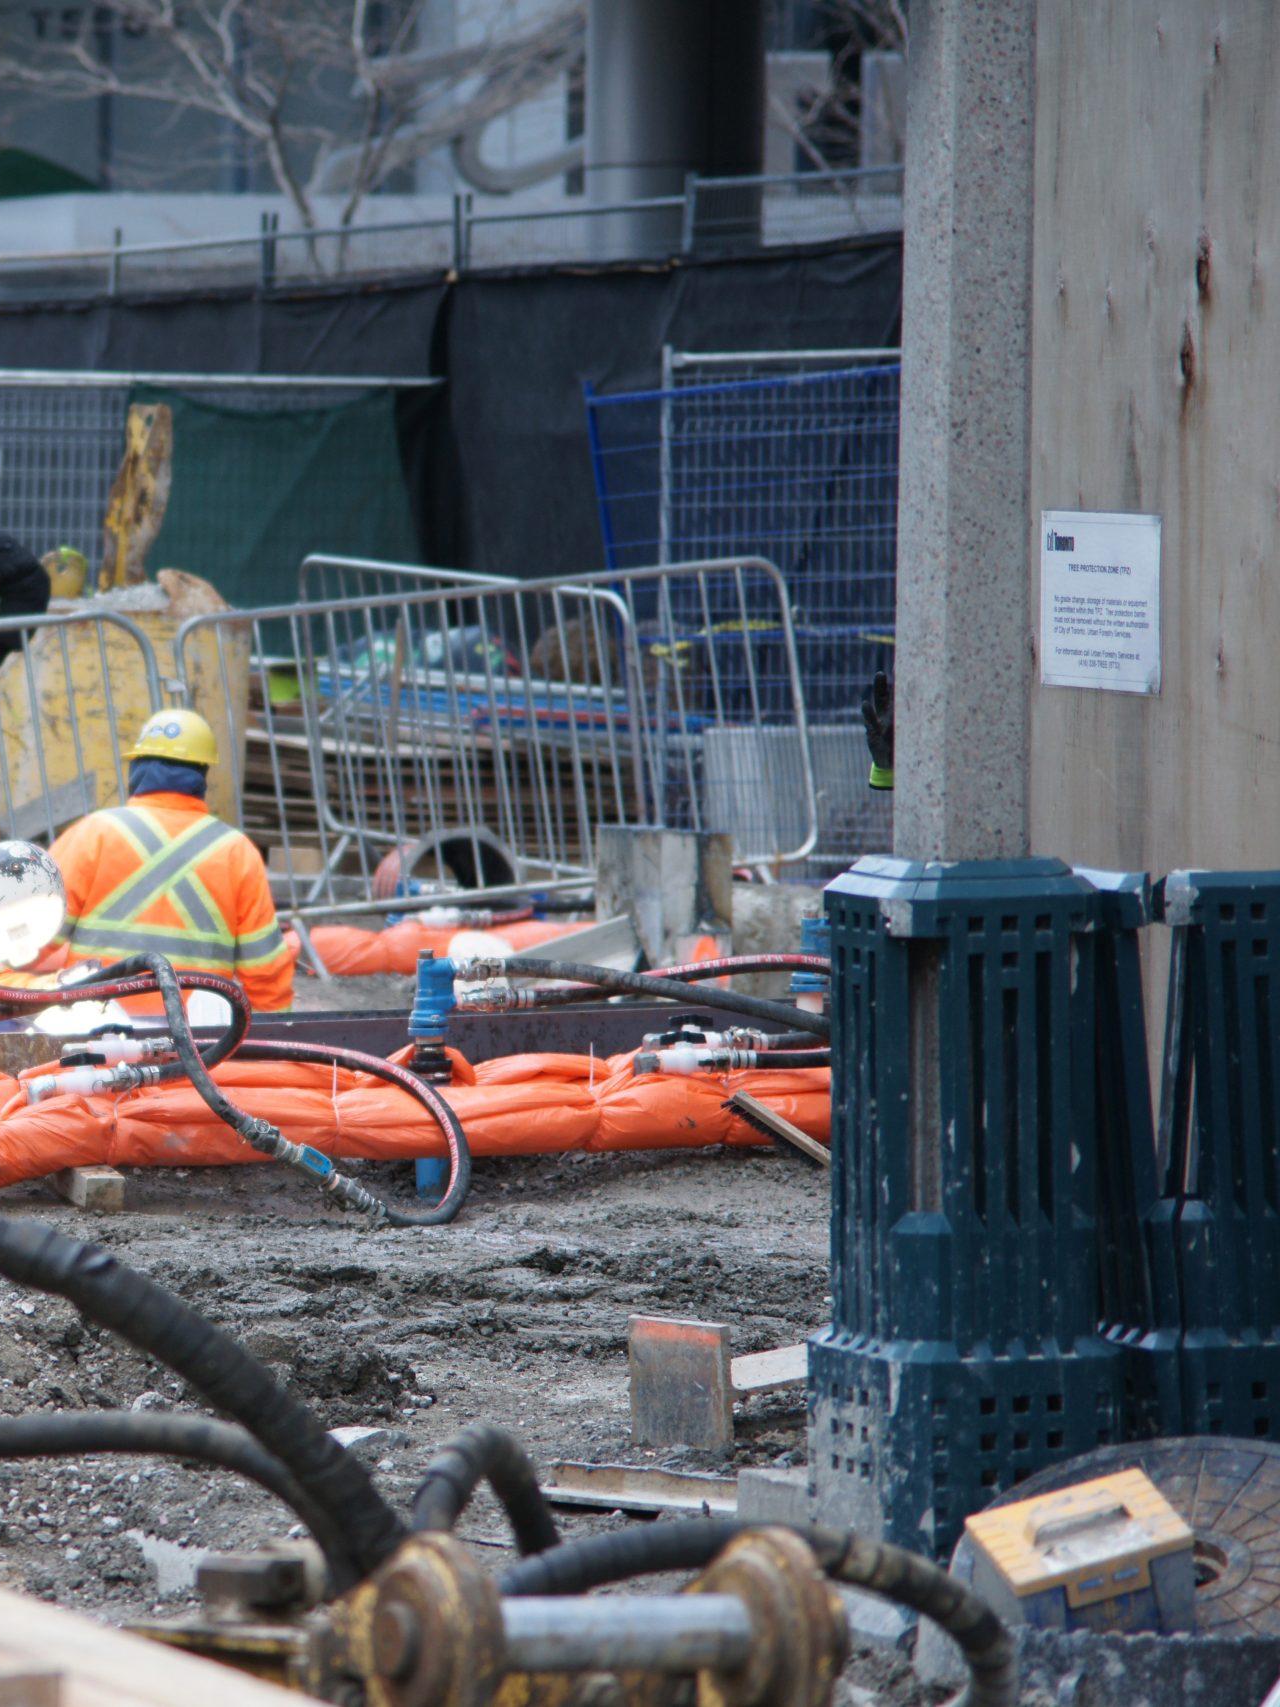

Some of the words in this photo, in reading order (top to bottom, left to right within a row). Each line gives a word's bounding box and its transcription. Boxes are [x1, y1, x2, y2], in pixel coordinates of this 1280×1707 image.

[1068, 563, 1079, 573] TREE
[1080, 564, 1107, 574] PROTECTION
[1108, 566, 1119, 575] ZONE
[1120, 566, 1131, 576] (TPZ)
[667, 966, 682, 976] PSI
[117, 979, 145, 993] TANK
[188, 977, 237, 995] SUCTION
